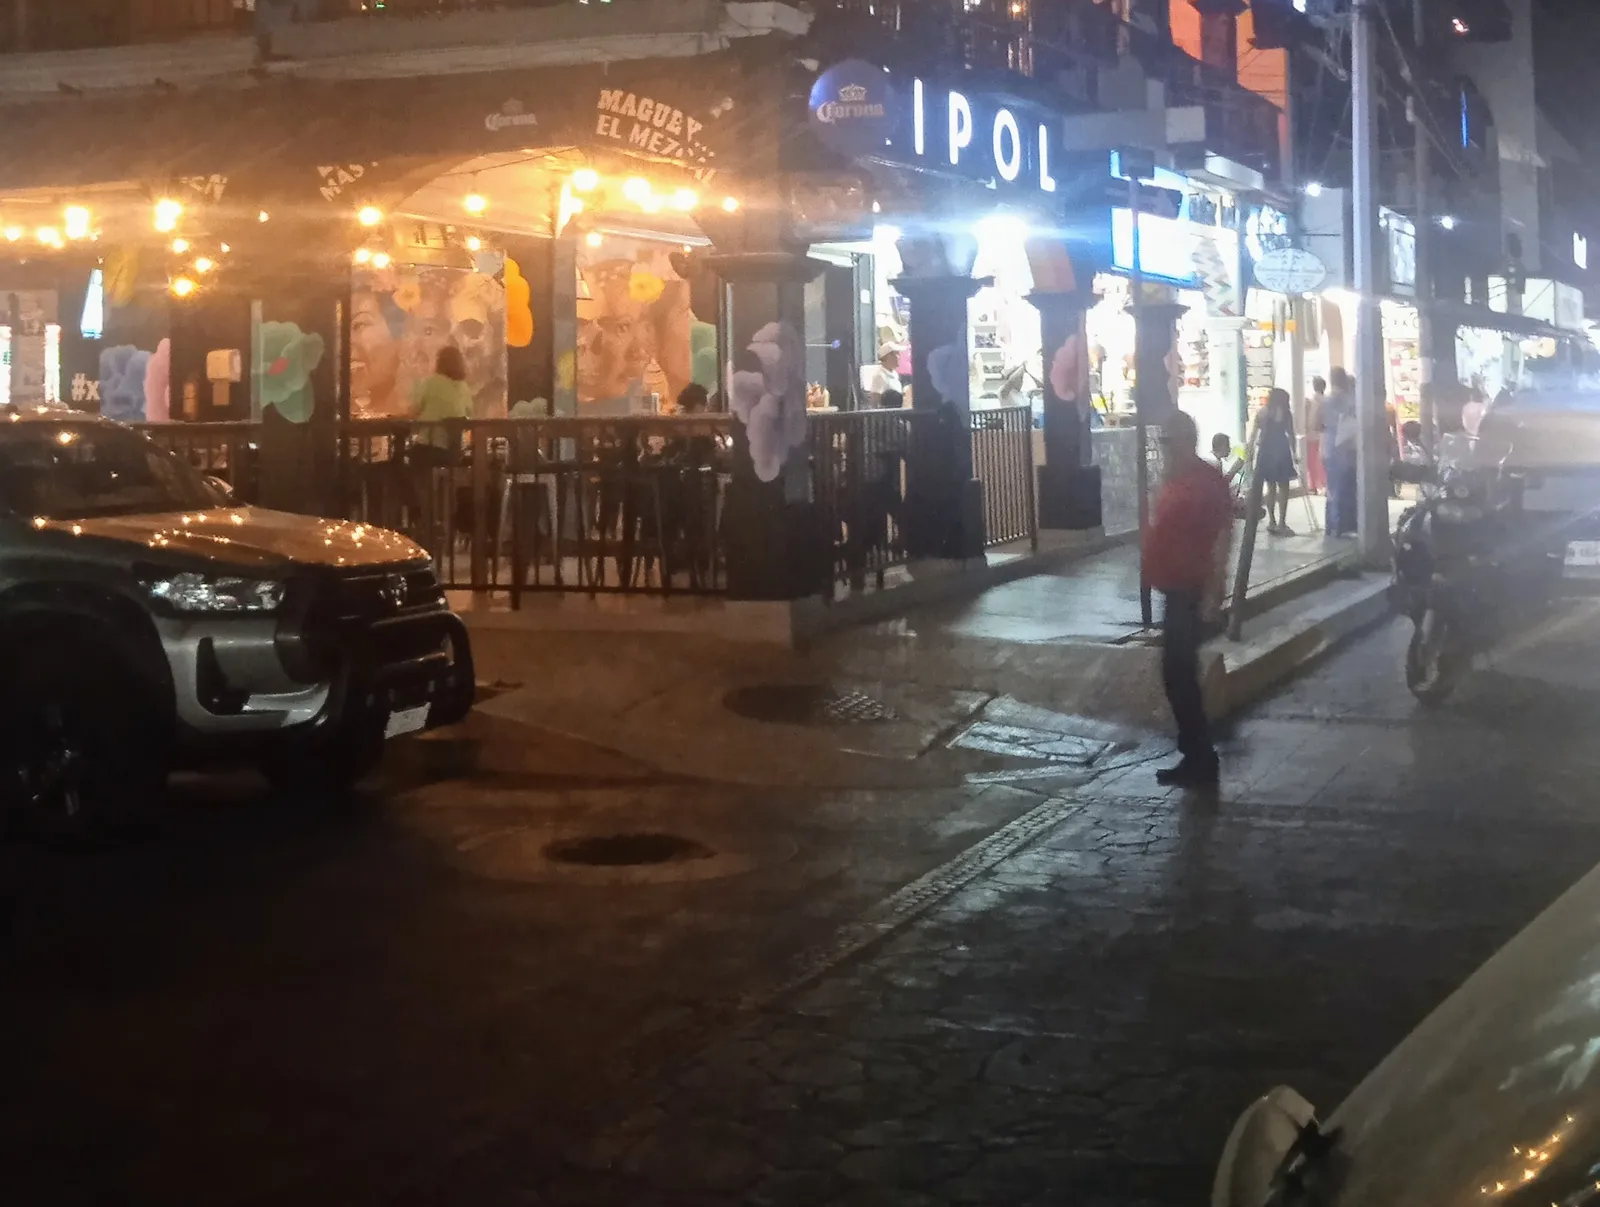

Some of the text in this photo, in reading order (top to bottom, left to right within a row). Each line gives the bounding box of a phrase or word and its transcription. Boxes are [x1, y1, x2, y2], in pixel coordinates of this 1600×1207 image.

[597, 89, 702, 142] MAGUEY
[815, 101, 885, 124] Corona
[595, 114, 622, 139] EL
